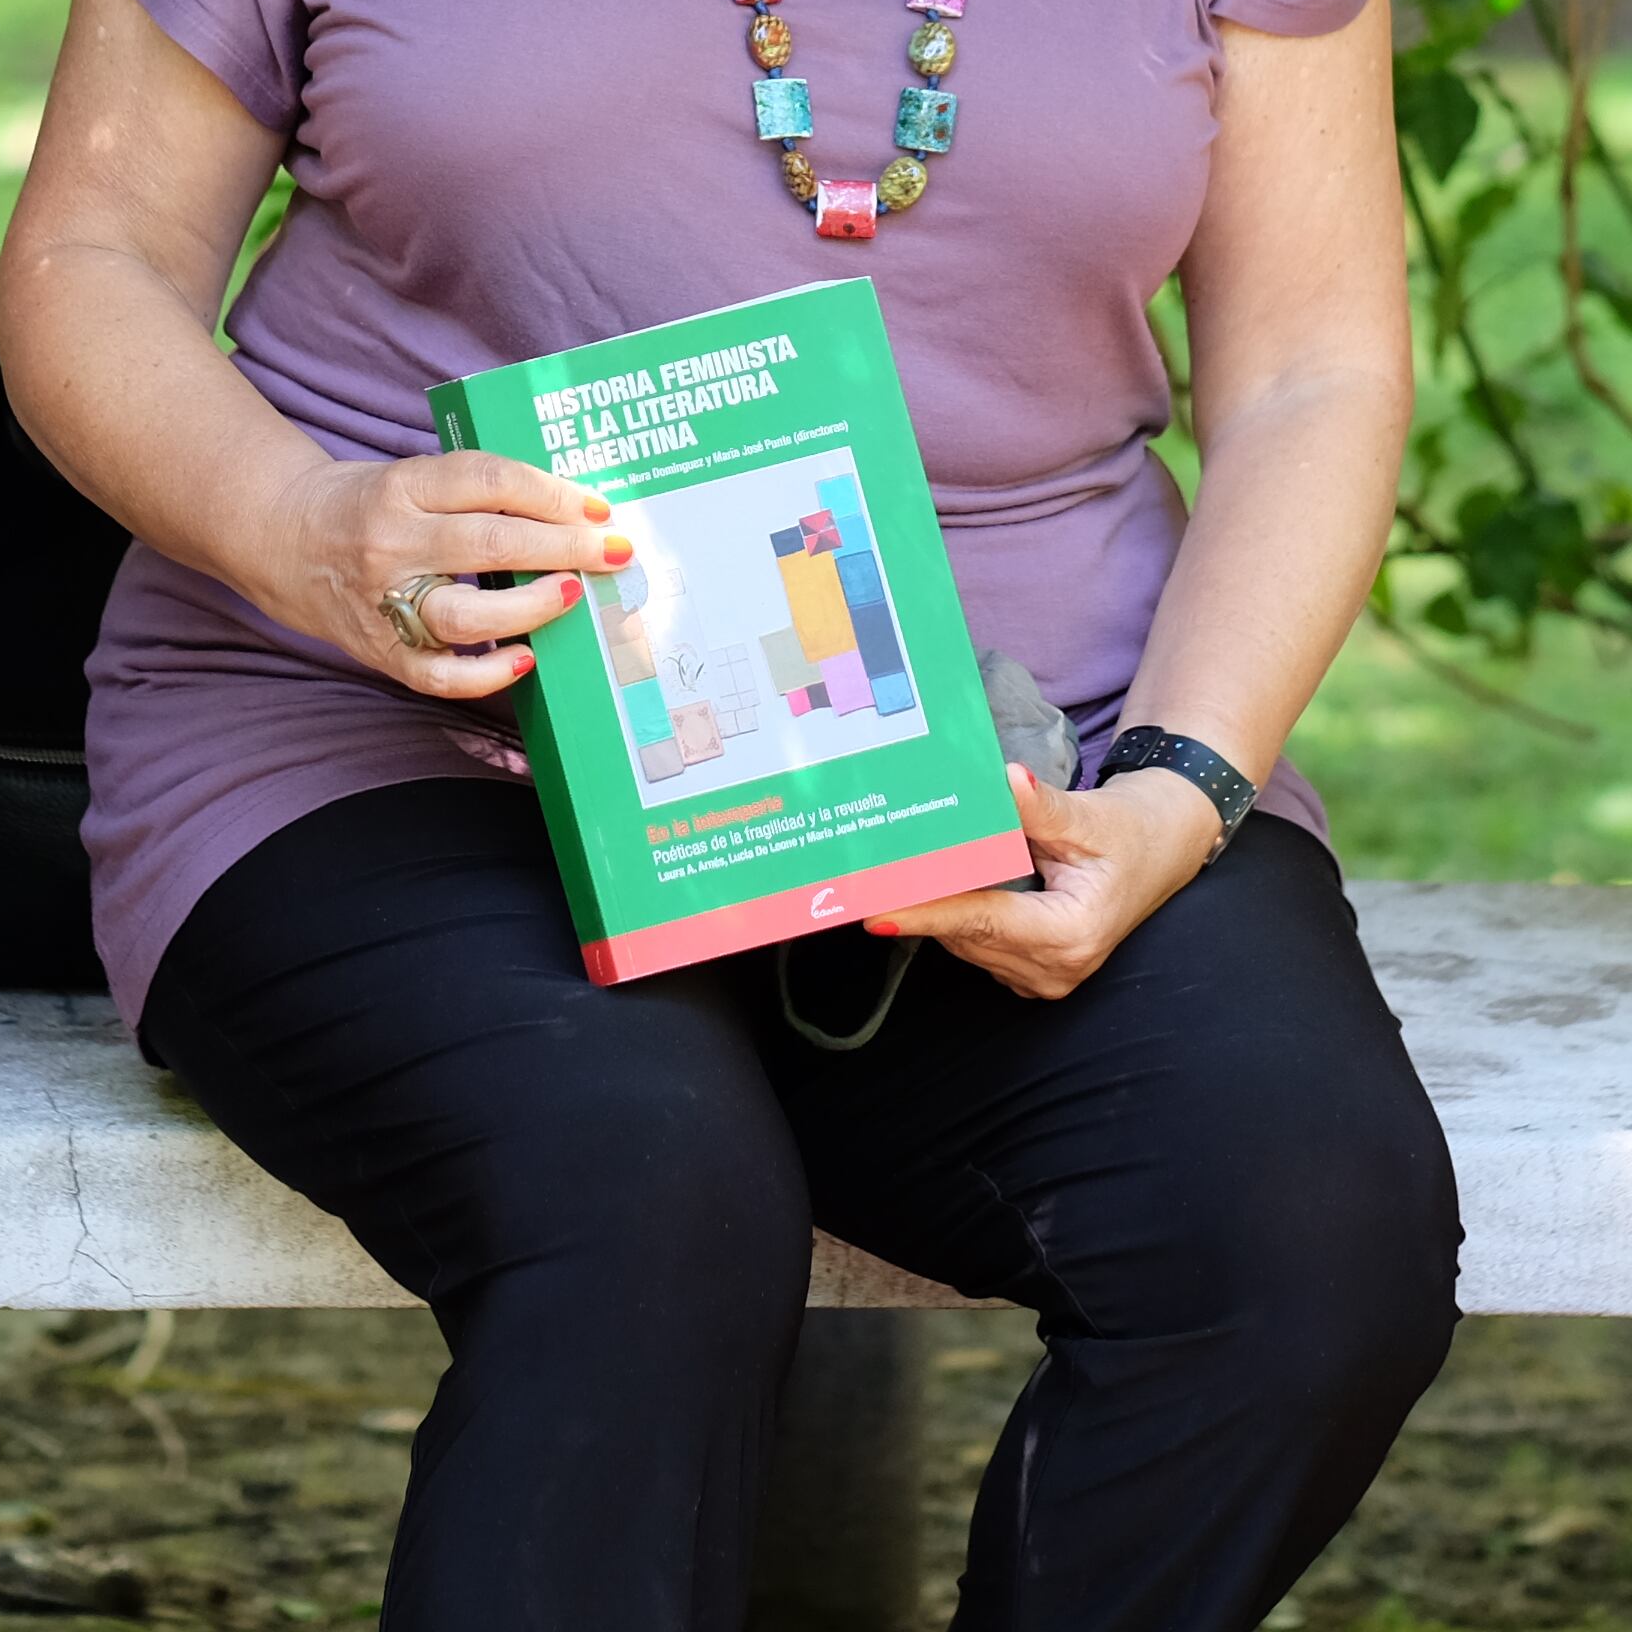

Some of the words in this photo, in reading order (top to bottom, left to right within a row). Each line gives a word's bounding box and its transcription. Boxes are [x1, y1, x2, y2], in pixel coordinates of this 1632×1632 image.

[533, 370, 657, 422] HISTORIA
[659, 334, 798, 390] FEMINISTA
[541, 419, 579, 451] DE
[582, 410, 620, 442] LA
[623, 370, 779, 431] LITERATURA
[551, 421, 698, 482] ARGENTINA
[705, 456, 712, 467] y
[652, 841, 708, 866] Poéticas
[711, 835, 728, 851] de
[729, 831, 743, 846] la
[744, 812, 806, 841] fragilidad
[808, 812, 816, 828] y
[818, 808, 833, 822] la
[834, 793, 887, 818] revuelta
[687, 864, 698, 875] A.
[798, 836, 805, 847] y
